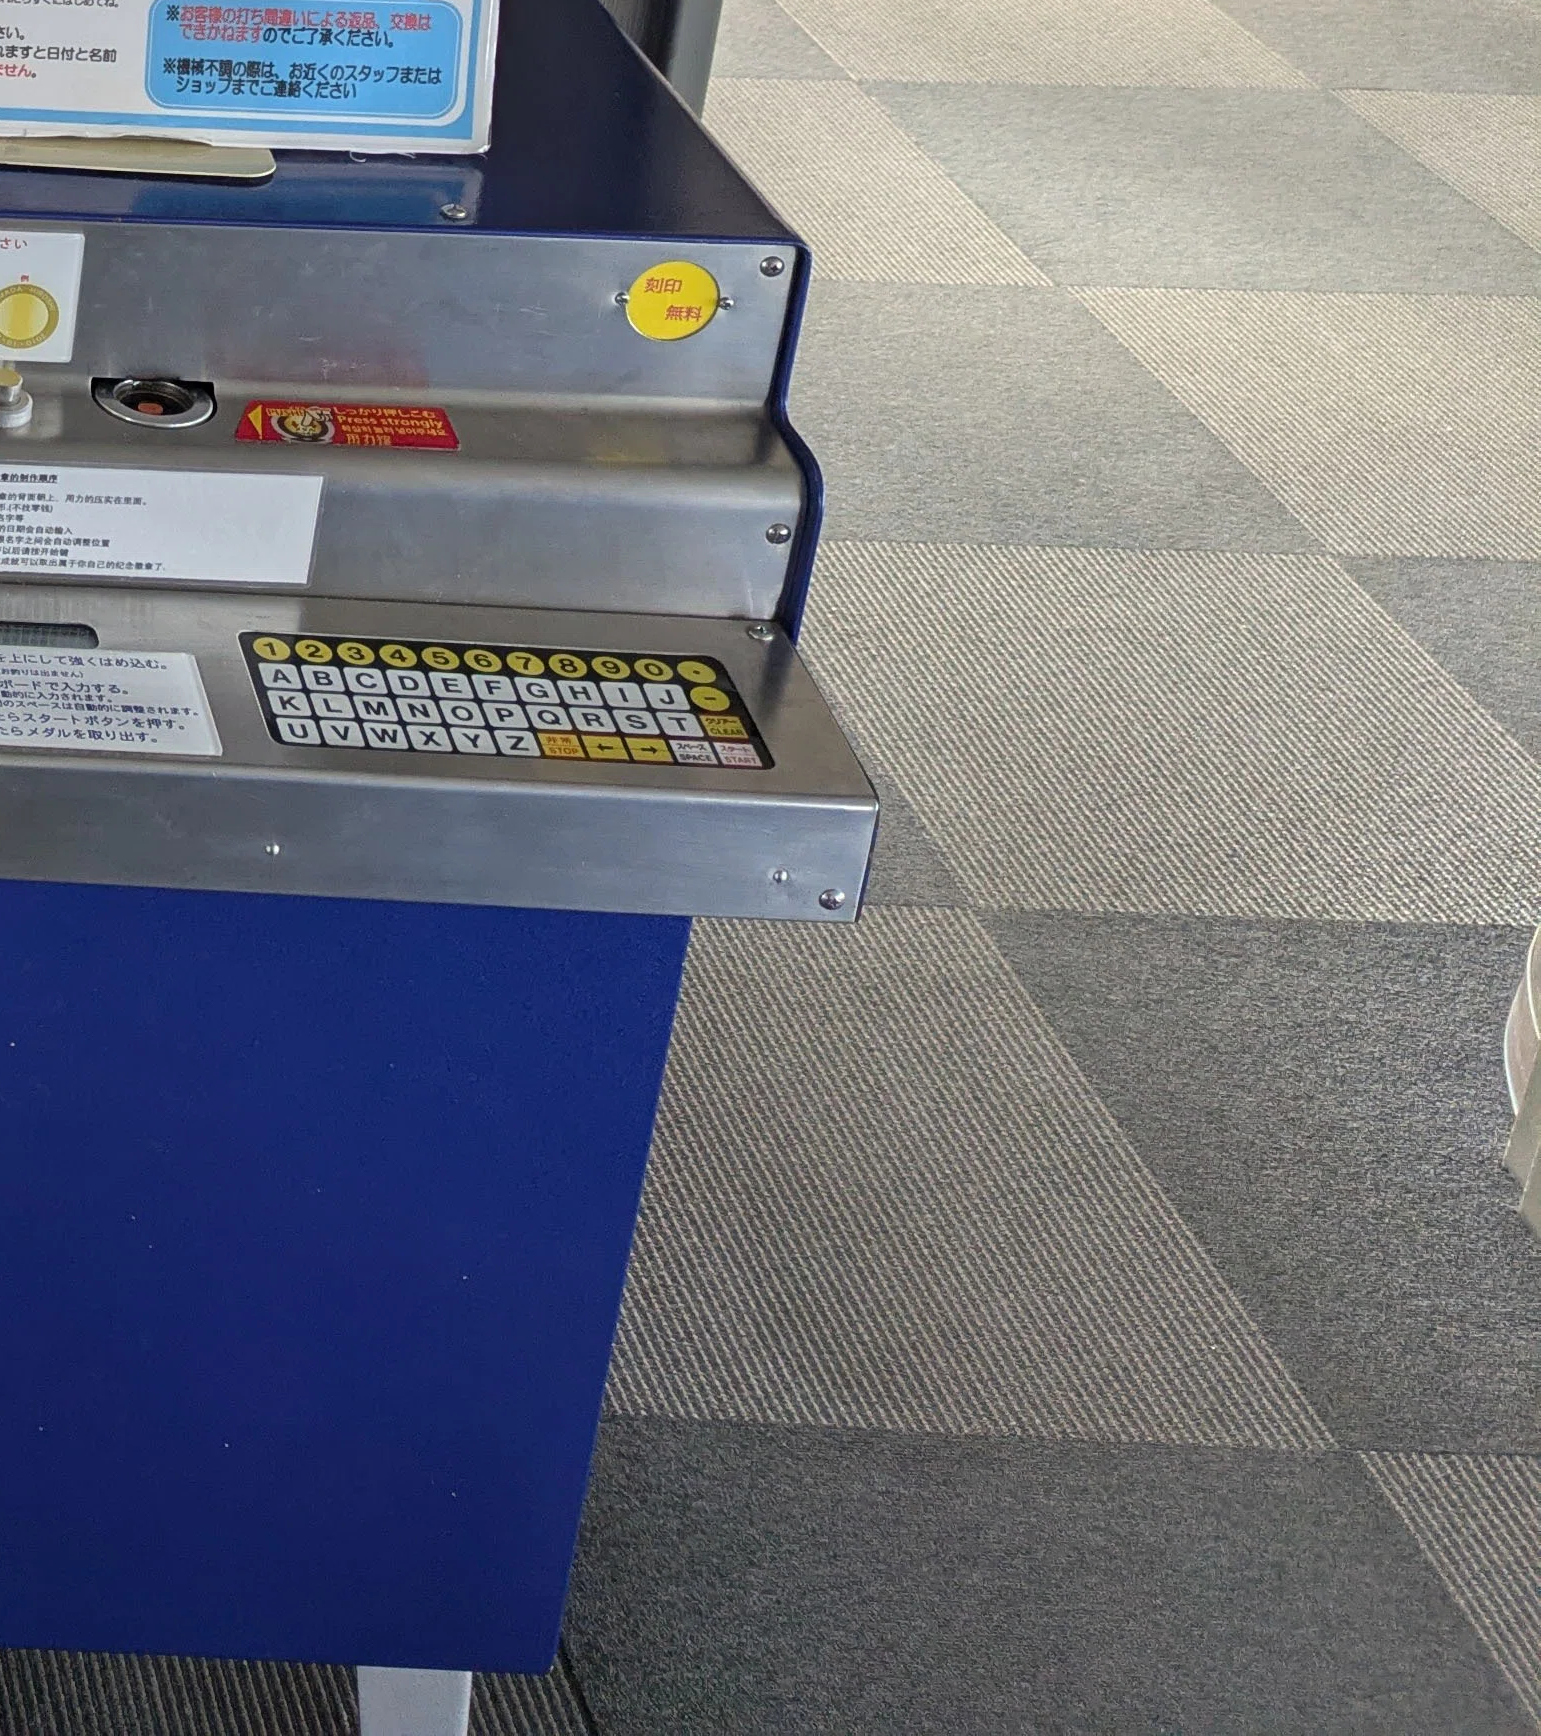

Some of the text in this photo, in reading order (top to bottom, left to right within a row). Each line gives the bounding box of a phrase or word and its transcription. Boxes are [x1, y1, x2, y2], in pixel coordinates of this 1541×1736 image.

[180, 23, 394, 49] できかねますのでご了承ください。
[176, 76, 357, 99] ショップまでご連絡ください
[644, 277, 682, 294] 刻印
[665, 304, 701, 322] 無料
[338, 415, 443, 428] Press strongly
[263, 642, 663, 676] 1 2 3 4 5 6 7 8 9 0
[710, 728, 744, 736] CLEAR
[548, 747, 758, 765] STOP SPACE START
